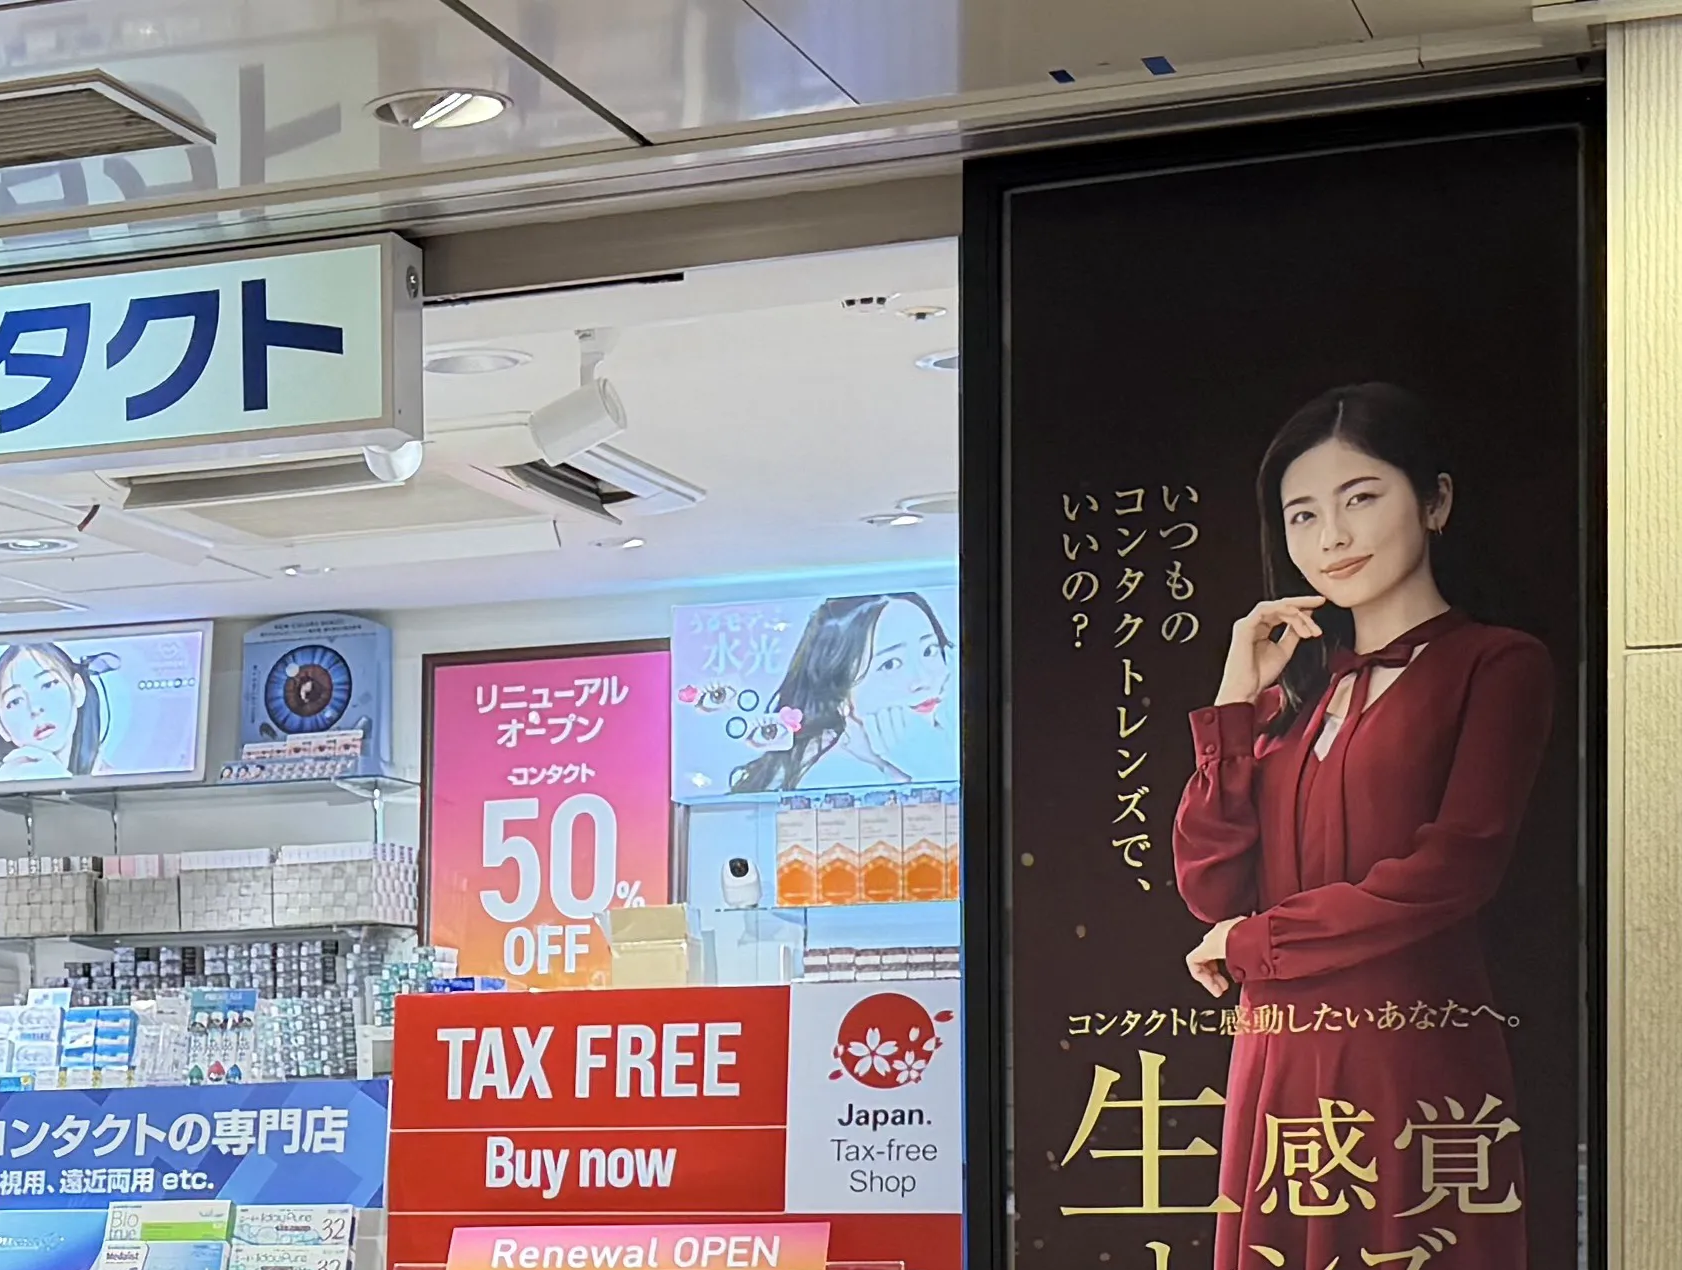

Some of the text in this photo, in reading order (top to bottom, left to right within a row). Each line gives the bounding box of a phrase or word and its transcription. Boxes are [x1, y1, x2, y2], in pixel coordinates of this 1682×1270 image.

[1160, 485, 1199, 644] いつもの
[475, 676, 629, 714] リニューアル
[1112, 487, 1151, 891] コンタクトレンズで、
[496, 711, 605, 749] オープン
[508, 762, 596, 787] コンタクト
[503, 924, 592, 977] OFF
[1068, 999, 1521, 1038] コンタクトに感動したいあなたへ。
[436, 1021, 743, 1101] TAX FREE
[837, 1103, 934, 1132] Japan.
[1060, 1049, 1522, 1219] 生感覚
[484, 1136, 677, 1200] Buy now
[829, 1137, 939, 1164] Tax-free
[162, 1171, 215, 1191] etc.
[848, 1168, 917, 1198] Shop
[489, 1235, 782, 1270] Renewal OPEN
